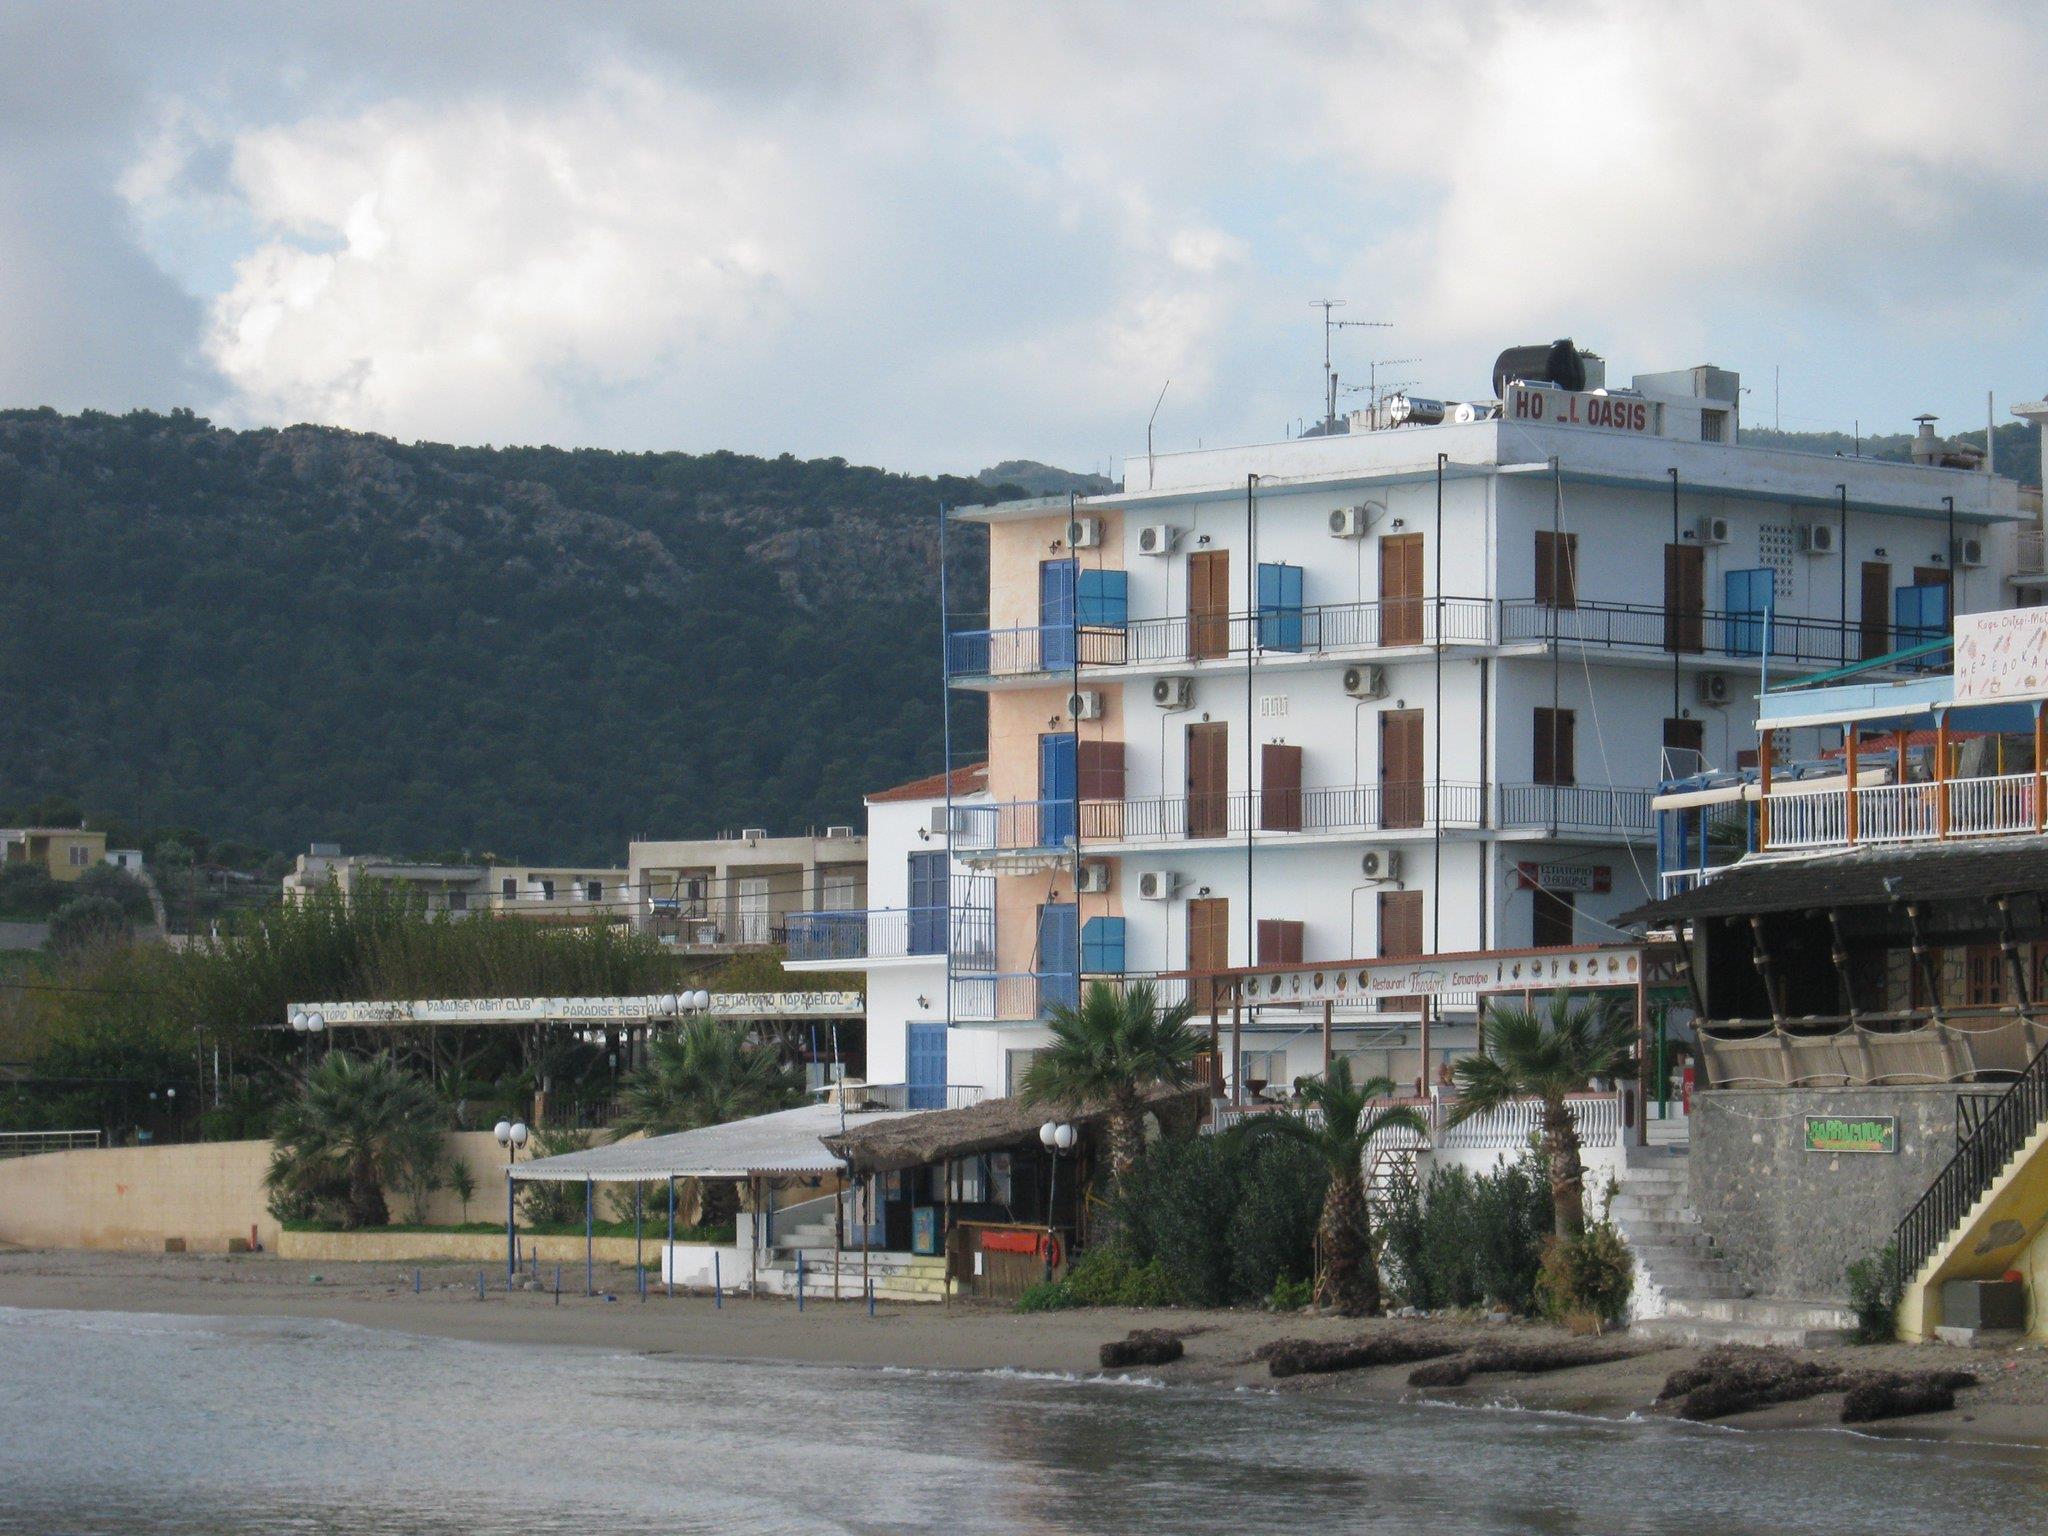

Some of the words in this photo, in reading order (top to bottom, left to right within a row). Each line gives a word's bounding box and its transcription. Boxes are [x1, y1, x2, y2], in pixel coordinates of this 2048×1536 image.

[1588, 398, 1646, 431] OASIS
[1372, 975, 1406, 992] Restaurant
[427, 1001, 470, 1012] PARADISE
[506, 1000, 531, 1011] CLUB
[562, 1005, 614, 1017] PARADISE
